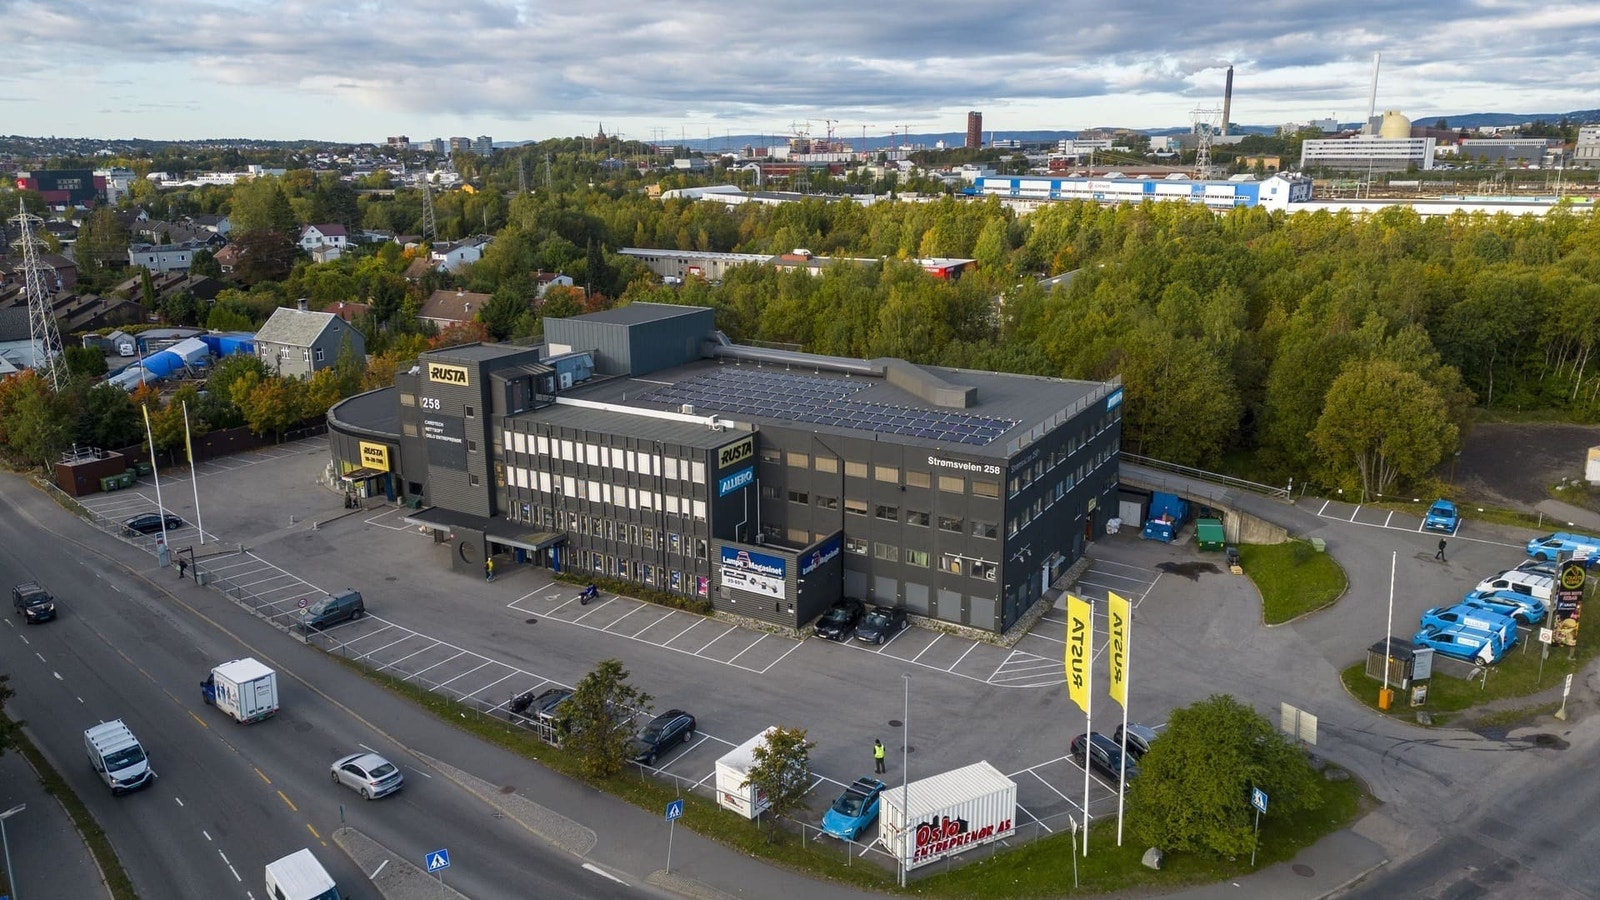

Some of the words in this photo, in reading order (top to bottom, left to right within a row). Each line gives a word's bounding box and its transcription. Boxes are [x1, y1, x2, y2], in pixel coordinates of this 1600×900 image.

[431, 367, 466, 383] RUSTA
[422, 397, 441, 410] 258
[363, 446, 384, 457] RUSTA
[721, 440, 752, 464] RUSTA
[928, 456, 982, 472] Strømsveien
[984, 465, 1000, 474] 258
[721, 471, 752, 493] ALLIERO
[912, 825, 994, 863] ENTREPRENØR
[996, 819, 1011, 833] AS
[916, 818, 960, 847] Oslo
